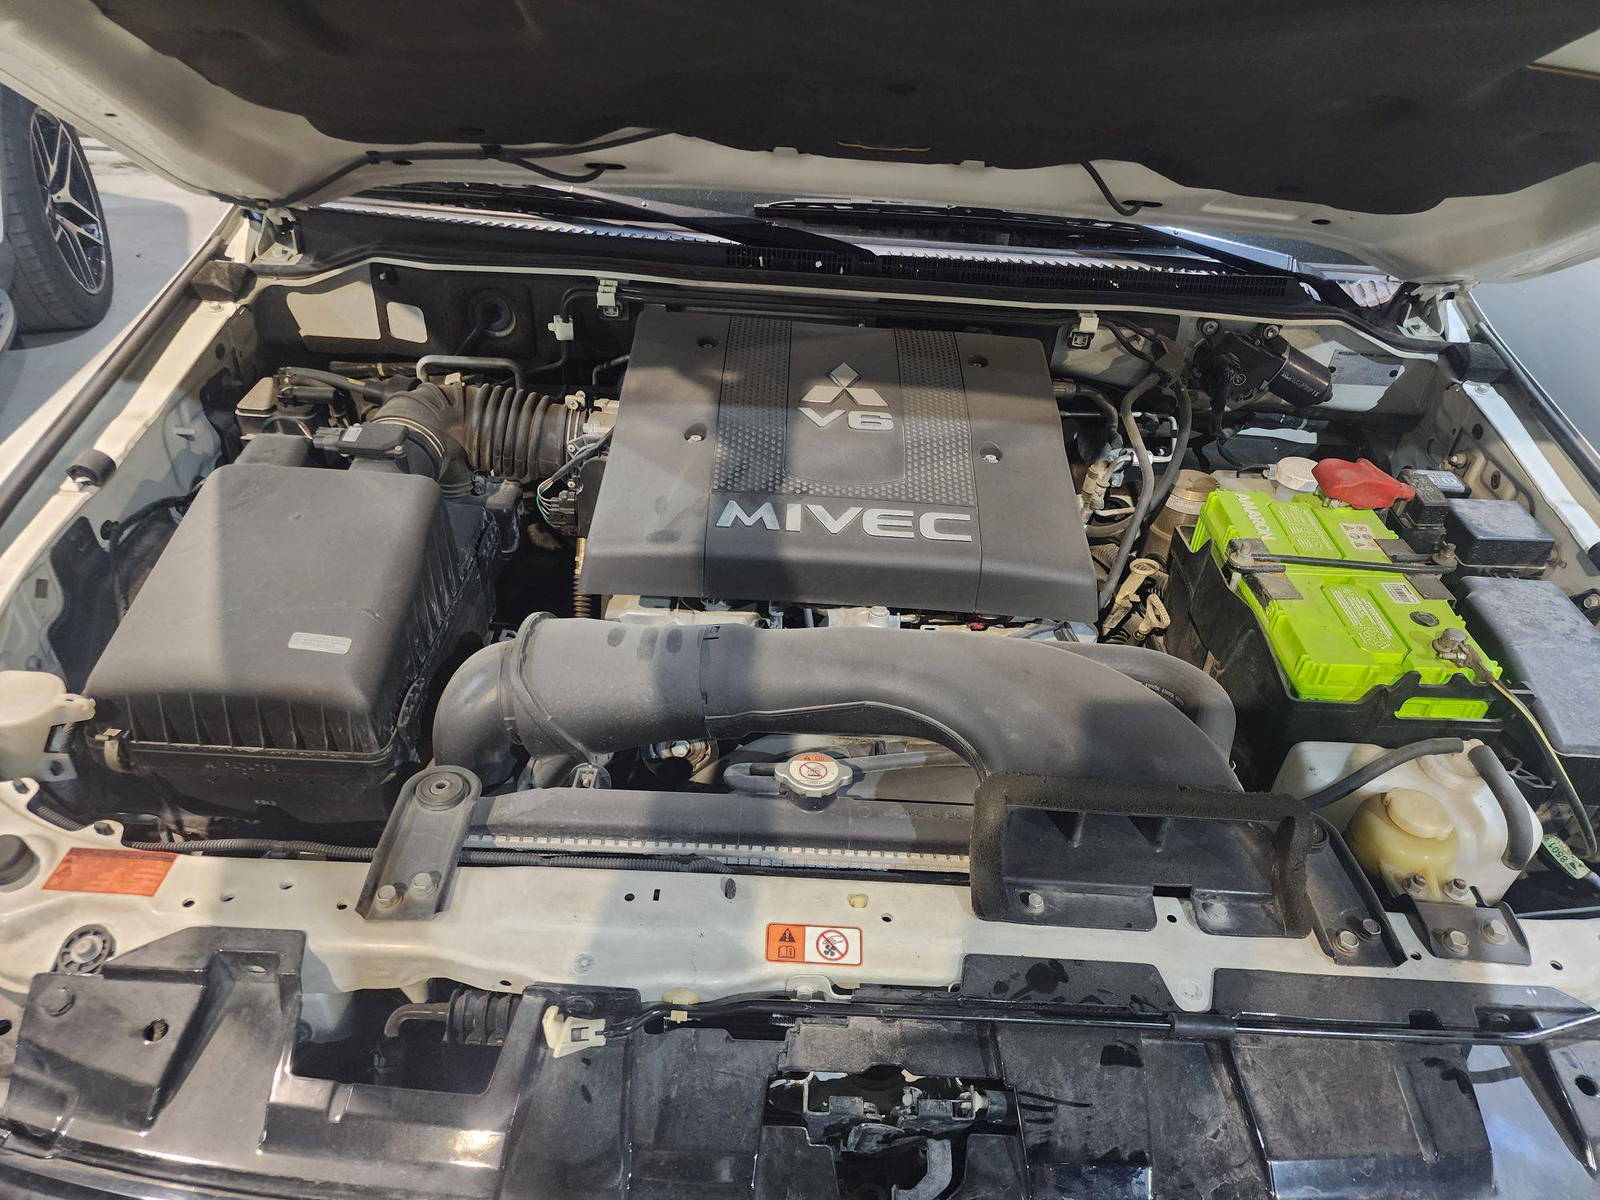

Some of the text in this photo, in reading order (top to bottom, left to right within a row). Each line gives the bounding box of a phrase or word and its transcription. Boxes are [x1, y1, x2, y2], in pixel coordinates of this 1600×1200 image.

[798, 406, 894, 431] V6
[715, 500, 973, 542] MIVEC
[1235, 493, 1277, 540] AMARON
[1548, 842, 1569, 863] 8501
